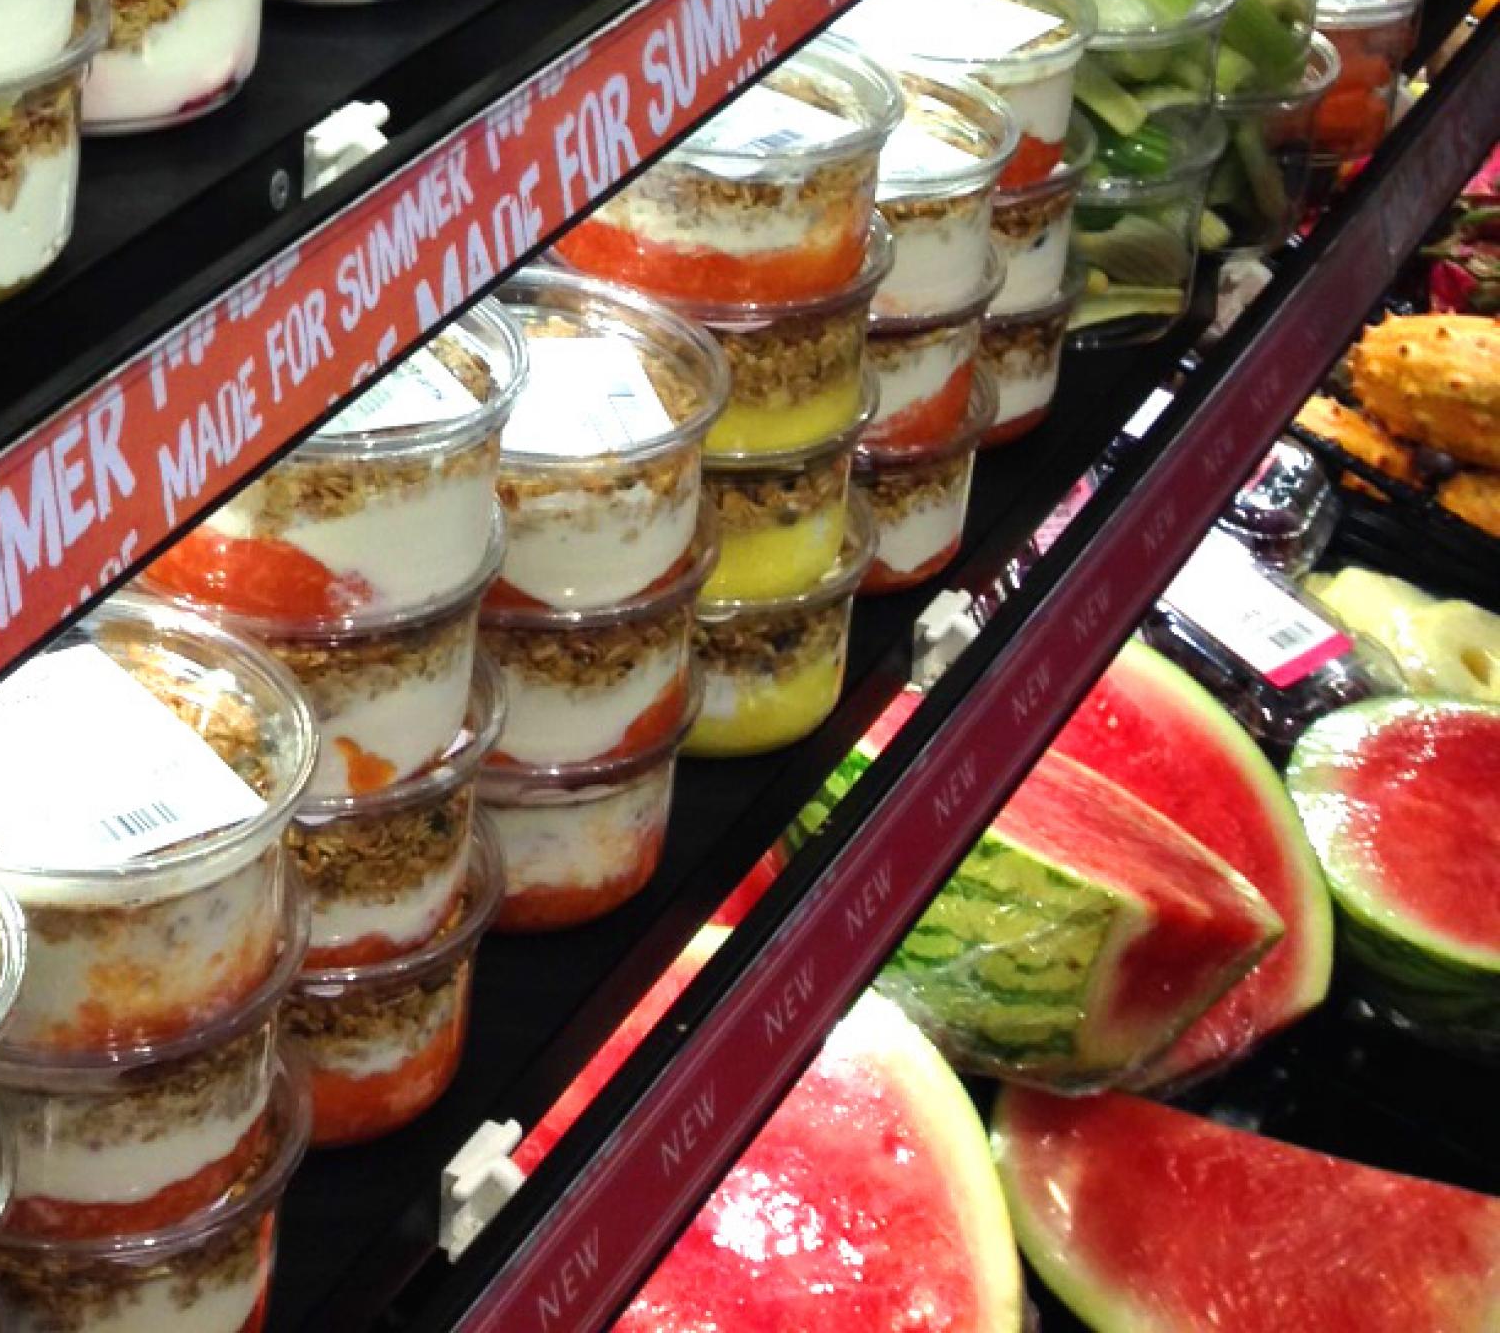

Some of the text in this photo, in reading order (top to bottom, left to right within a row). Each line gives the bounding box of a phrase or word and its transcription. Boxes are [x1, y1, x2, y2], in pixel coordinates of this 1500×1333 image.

[554, 73, 641, 221] FOR
[157, 358, 263, 528] MADE
[266, 288, 334, 403] FOR
[336, 139, 474, 331] SUMMER
[1072, 588, 1111, 643] NEW
[1010, 661, 1051, 725] NEW
[933, 753, 976, 825] NEW
[848, 861, 892, 931] NEW
[764, 955, 815, 1045] NEW
[659, 1080, 717, 1177] NEW
[536, 1226, 600, 1331] NEW
